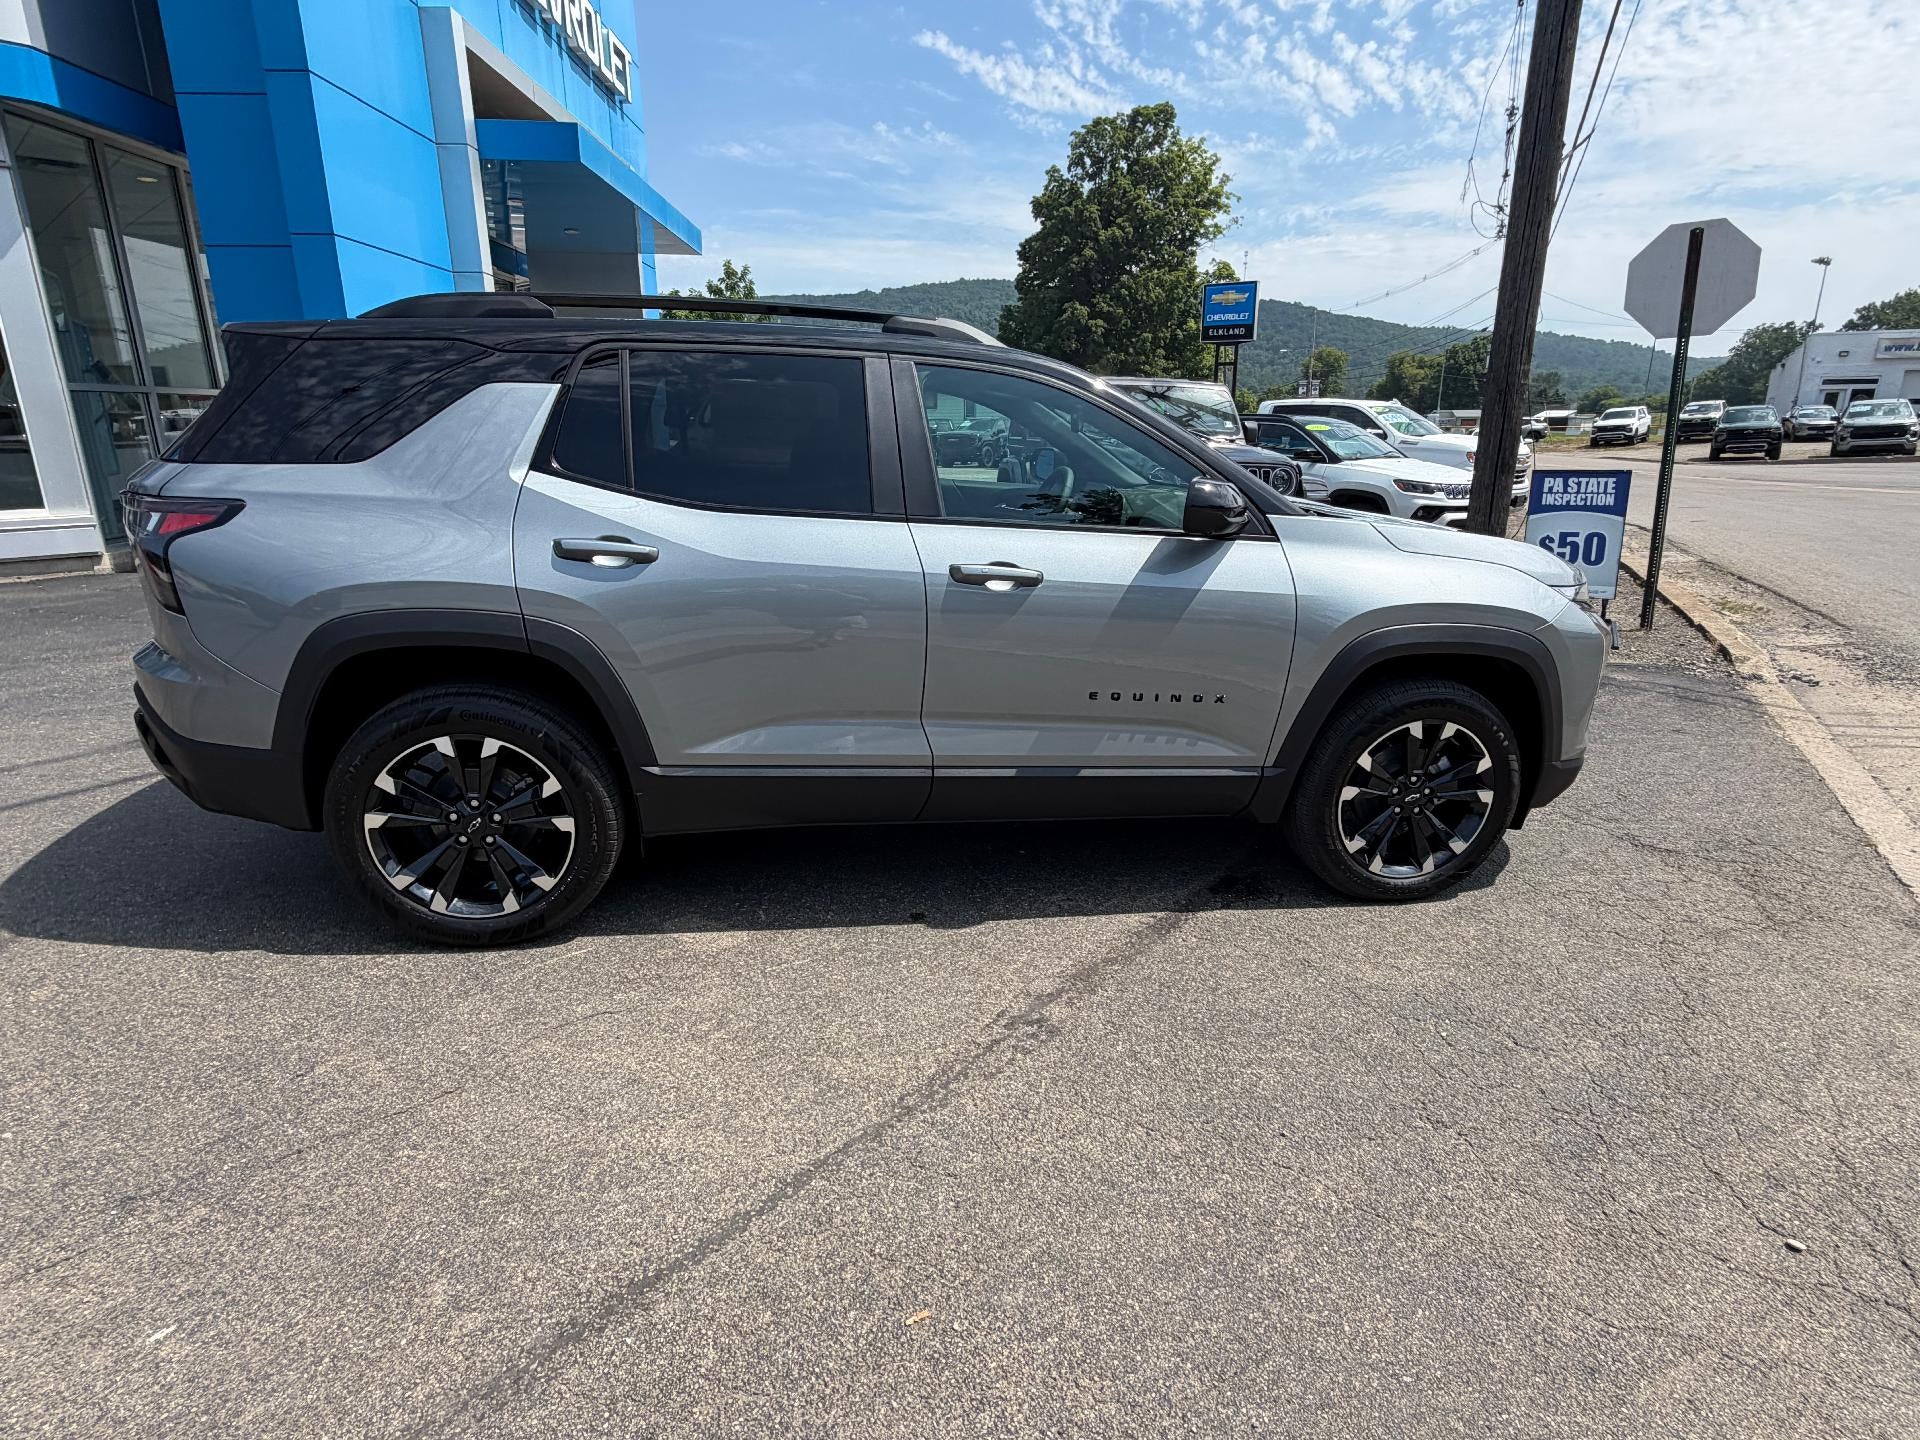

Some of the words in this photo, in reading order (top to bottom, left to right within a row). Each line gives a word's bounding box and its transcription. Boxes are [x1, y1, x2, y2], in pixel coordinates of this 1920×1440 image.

[1207, 312, 1249, 321] CHEVROLET
[1209, 328, 1245, 336] ELKLAND
[1543, 477, 1564, 493] PA
[1567, 477, 1617, 493] STATE
[1541, 493, 1615, 506] INSPECTION
[1088, 691, 1227, 704] EQUINOX
